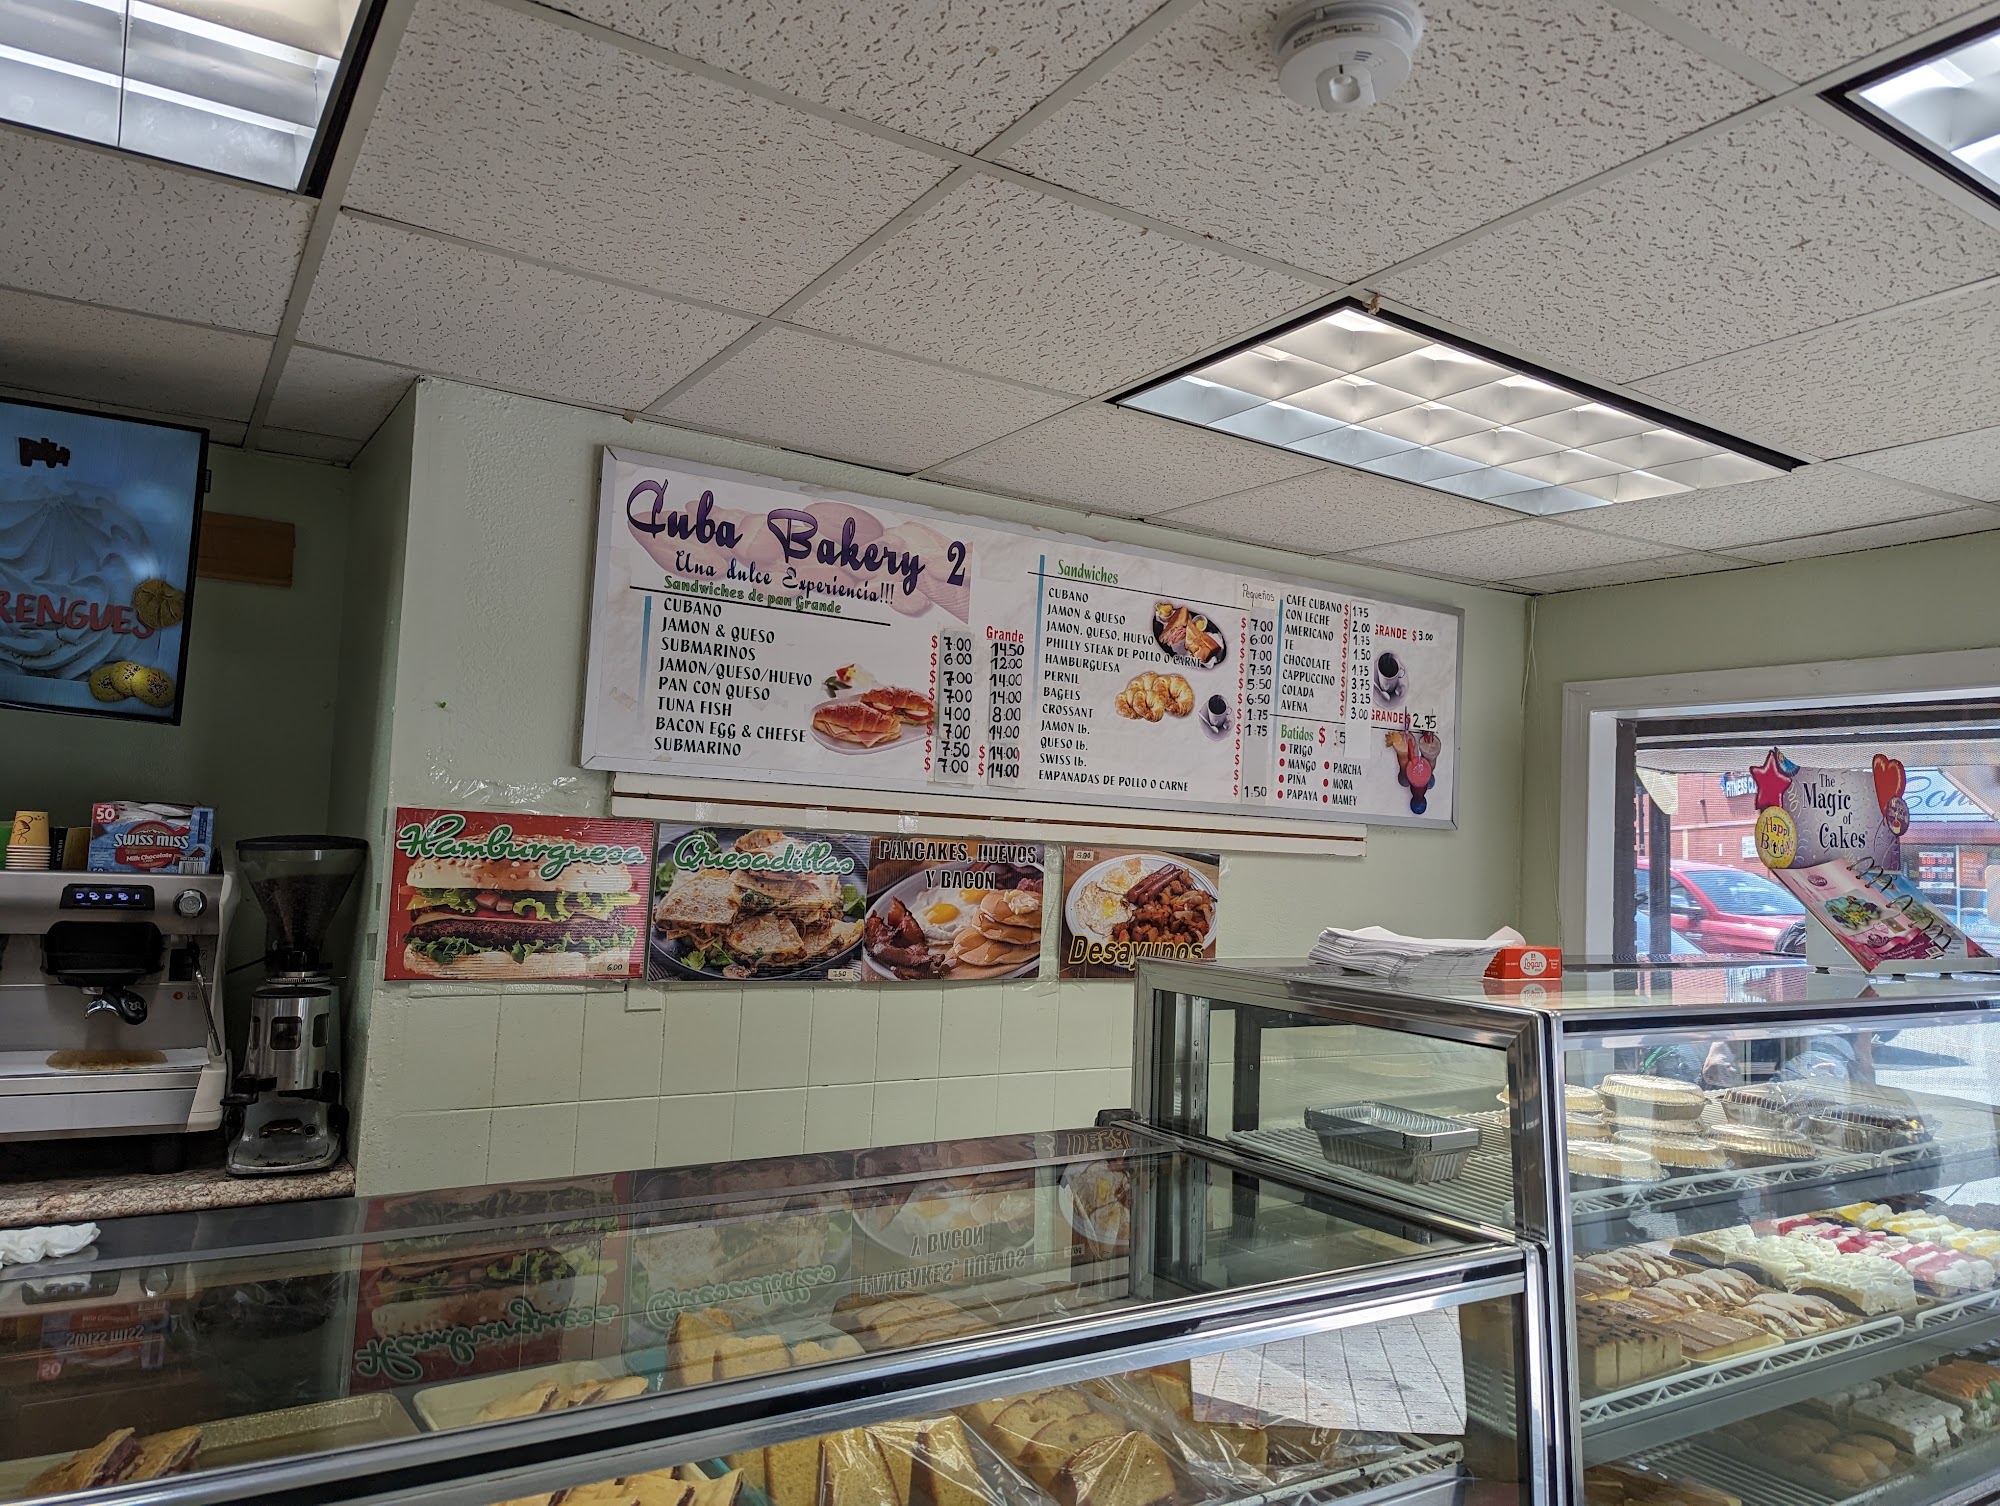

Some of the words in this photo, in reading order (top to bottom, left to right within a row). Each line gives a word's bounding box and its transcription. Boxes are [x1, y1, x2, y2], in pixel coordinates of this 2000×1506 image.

[627, 479, 743, 548] Cuba
[767, 508, 925, 595] Bakery
[947, 541, 966, 586] 2
[676, 550, 717, 577] Una
[727, 558, 772, 584] dulce
[783, 567, 894, 604] Experiencia!!!
[1058, 559, 1119, 584] Sandwiches
[664, 576, 744, 599] Sandwiches
[749, 589, 764, 603] de
[768, 595, 792, 607] pan
[795, 595, 841, 613] Grande
[1048, 588, 1089, 603] CUBANO
[664, 598, 722, 617] CUBANO
[1286, 594, 1306, 607] CAFE
[1309, 598, 1342, 613] CUBANO
[1047, 604, 1081, 618] JAMON
[1084, 610, 1091, 620] &
[1094, 611, 1126, 625] QUESO
[1285, 609, 1303, 621] CON
[1305, 612, 1330, 626] LECHE
[661, 617, 710, 635] JAMON
[715, 624, 726, 637] &
[731, 627, 775, 643] QUESO
[986, 626, 1024, 643] Grande
[1284, 624, 1334, 641] AMERICANO
[1123, 633, 1154, 645] HUEVO
[1285, 639, 1294, 650] TE
[661, 637, 756, 661] SUBMARINOS
[1046, 637, 1081, 653] PHILLY
[1084, 643, 1114, 656] STEAK
[1117, 647, 1129, 658] DE
[1132, 649, 1160, 662] POLLO
[1164, 653, 1169, 664] O
[1045, 654, 1120, 673] HAMBURGUESA
[1283, 654, 1331, 671] CHOCOLATE
[658, 657, 812, 686] JAMON/QUESO/HUEVO
[1044, 670, 1080, 685] PERNIL
[1282, 669, 1335, 686] CAPPUCCINO
[658, 677, 687, 692] PAN
[693, 681, 721, 695] CON
[726, 684, 770, 700] QUESO
[1043, 687, 1081, 701] BAGELS
[1282, 684, 1314, 698] COLADA
[657, 697, 695, 712] TUNA
[700, 701, 732, 716] FISH
[1042, 704, 1093, 718] CROSSANT
[1281, 699, 1308, 713] AVENA
[656, 717, 704, 734] BACON
[710, 722, 736, 739] EGG
[741, 725, 752, 738] &
[757, 726, 807, 743] CHEESE
[1040, 720, 1074, 733] JAMON
[1077, 723, 1090, 735] lb.
[1281, 724, 1314, 741] Batidos
[654, 737, 741, 756] SUBMARINO
[1040, 737, 1073, 749] QUESO
[1075, 740, 1088, 751] lb.
[1289, 743, 1313, 757] TRIGO
[1039, 753, 1071, 766] SWISS
[1074, 756, 1087, 767] lb.
[1288, 759, 1317, 772] MANGO
[1333, 762, 1362, 776] PARCHA
[1039, 770, 1099, 784] EMPANADAS
[1103, 775, 1115, 786] DE
[1118, 776, 1147, 789] POLLO
[1150, 779, 1156, 789] O
[1159, 780, 1189, 791] CARNE
[1287, 771, 1307, 785] PIÑA
[1332, 778, 1353, 791] MORA
[1819, 773, 1836, 788] The
[1286, 789, 1318, 801] PAPAYA
[1331, 794, 1358, 806] MAMEY
[1802, 782, 1851, 817] Magic
[96, 807, 115, 820] 50
[1843, 812, 1853, 825] of
[397, 814, 646, 880] Hamburguesa
[673, 834, 854, 875] Quesadillas
[879, 840, 972, 864] PANCAKES,
[977, 844, 1038, 864] HUEVOS
[925, 870, 936, 889] Y
[941, 870, 995, 890] BACON
[1068, 935, 1204, 971] Desayunos
[1523, 958, 1543, 970] Logan
